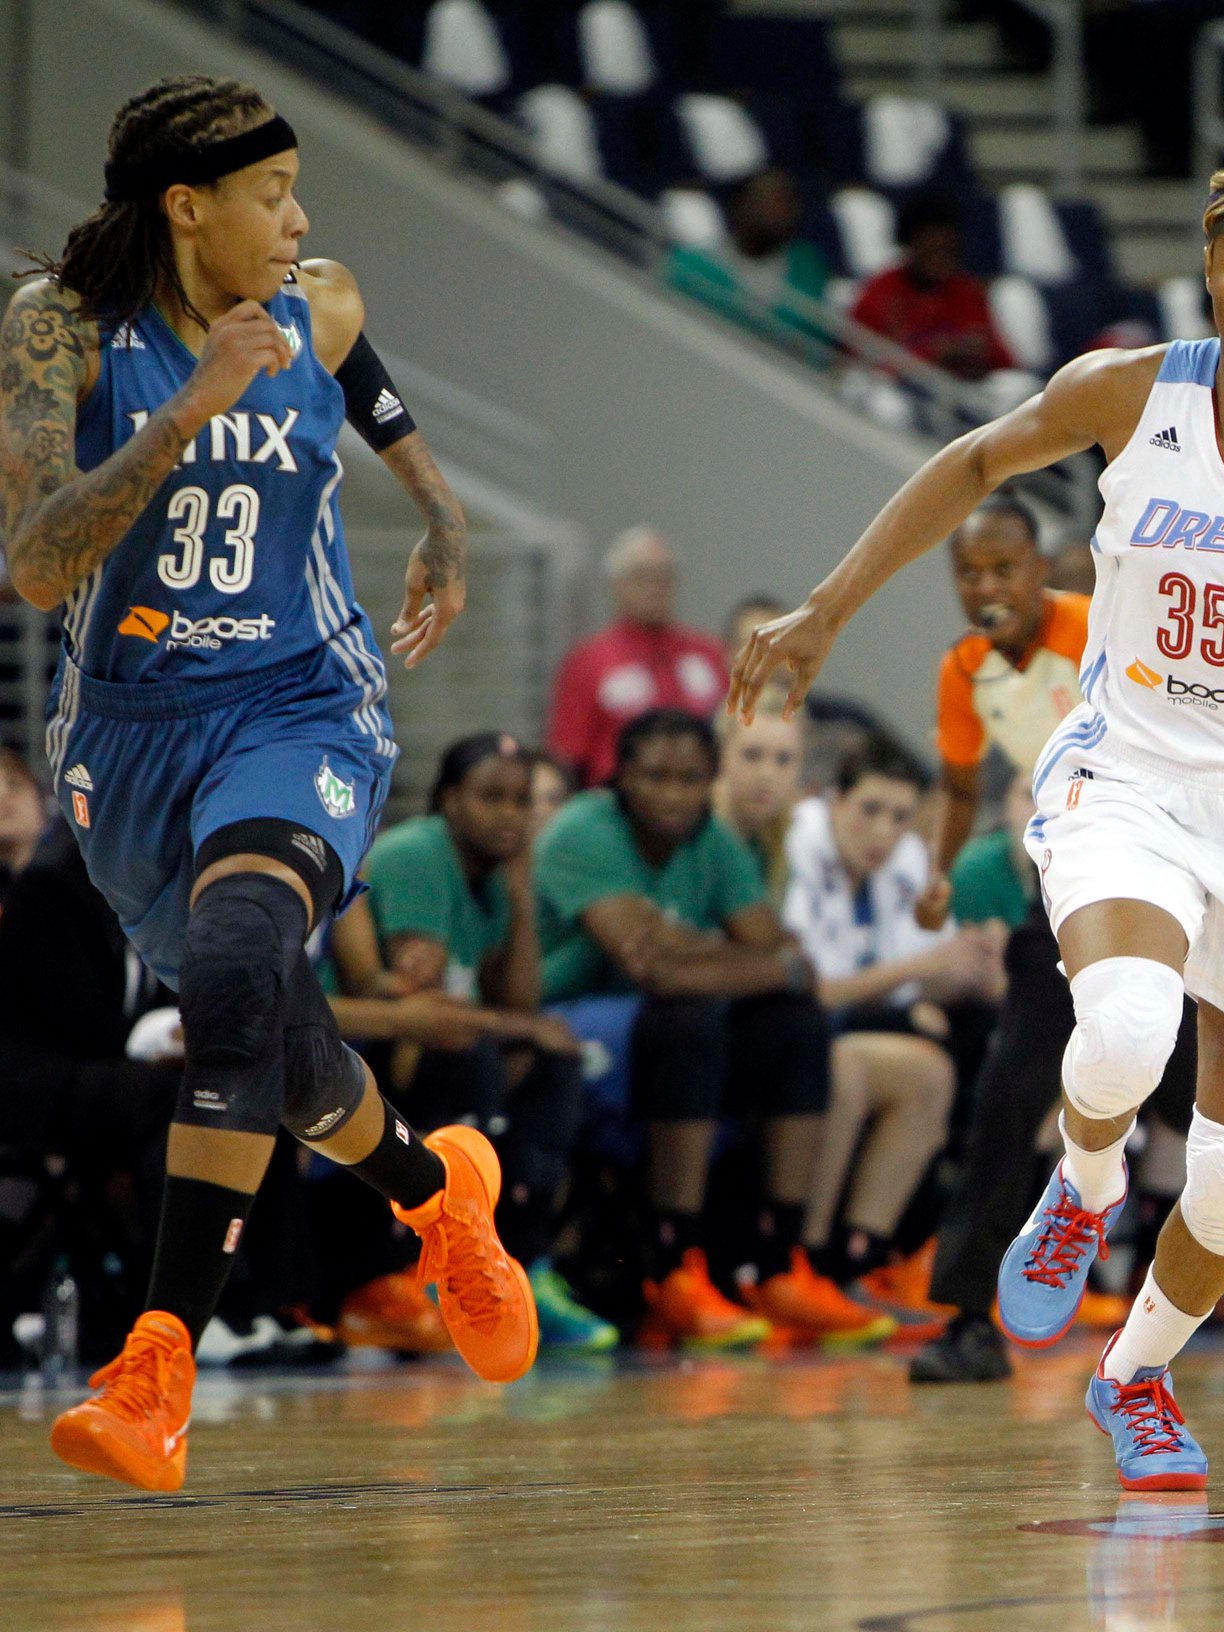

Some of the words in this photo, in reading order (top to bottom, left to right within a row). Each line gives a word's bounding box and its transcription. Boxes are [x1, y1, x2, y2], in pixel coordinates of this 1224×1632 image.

[372, 398, 401, 417] adidas
[127, 406, 300, 473] NX
[1149, 437, 1181, 452] adidas
[157, 484, 260, 594] 33
[171, 610, 276, 640] boost
[1167, 696, 1219, 710] mobile
